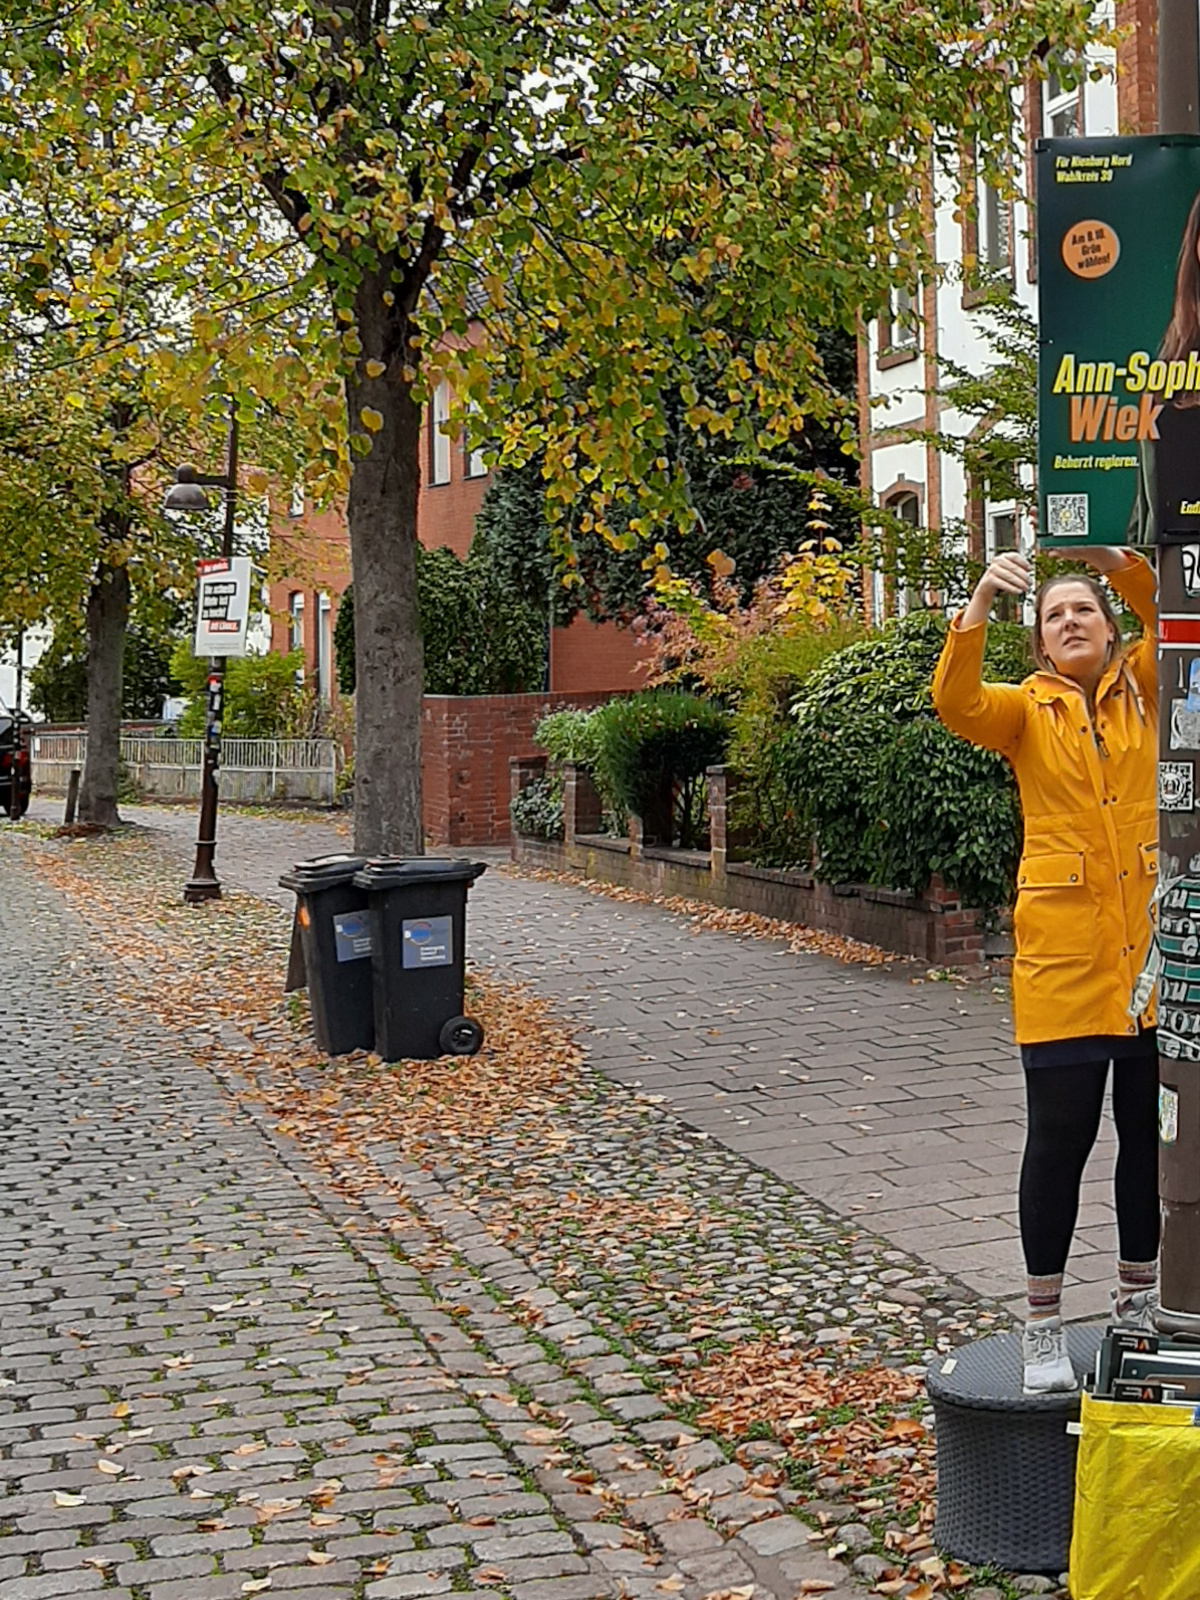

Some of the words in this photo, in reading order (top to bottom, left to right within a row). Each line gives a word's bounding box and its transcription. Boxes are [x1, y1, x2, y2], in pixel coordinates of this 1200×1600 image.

[1111, 153, 1134, 167] Nord
[1056, 170, 1100, 183] Wahlkreis
[1069, 394, 1166, 442] Wiek
[1054, 454, 1093, 470] Beherzt
[1094, 454, 1140, 472] regieren.
